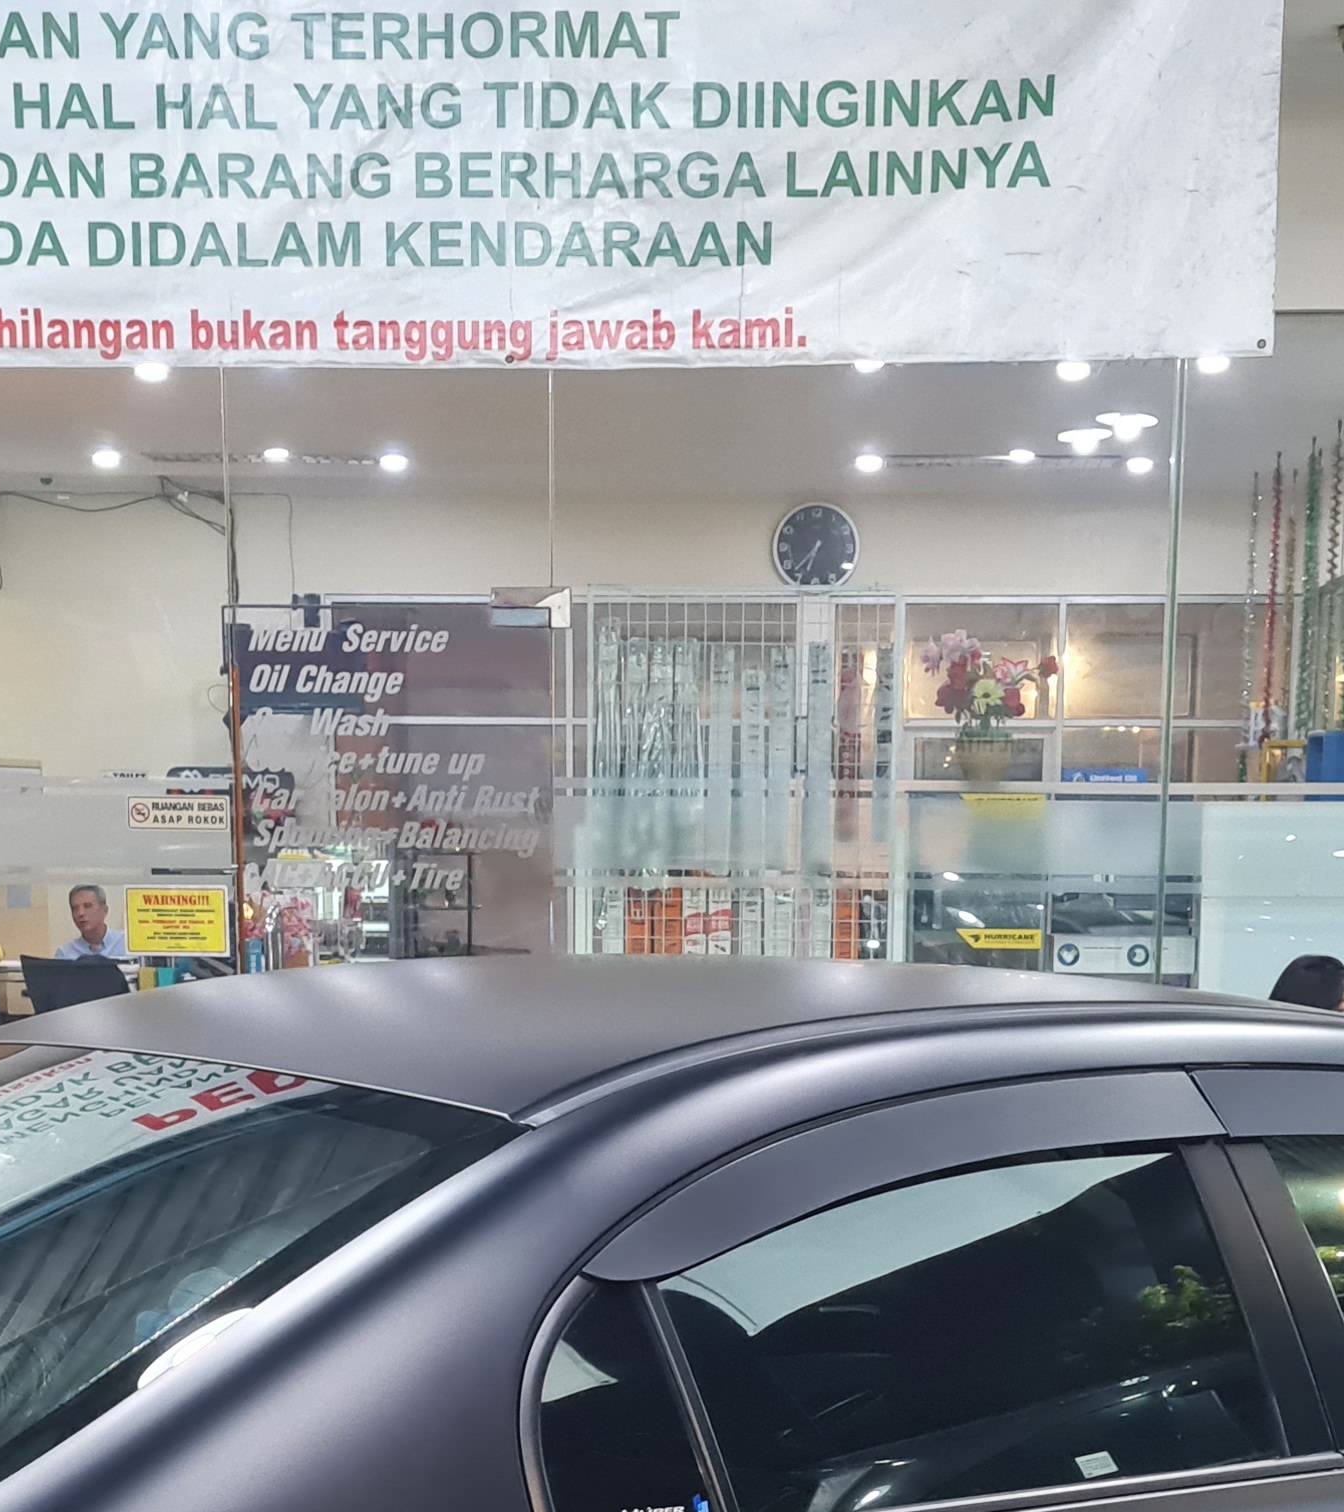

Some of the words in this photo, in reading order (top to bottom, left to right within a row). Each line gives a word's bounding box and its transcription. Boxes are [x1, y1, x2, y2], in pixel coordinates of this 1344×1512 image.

[101, 11, 270, 62] YANG
[290, 11, 680, 61] TERHORMAT
[12, 80, 137, 132] HAL
[156, 84, 275, 132] HAL
[297, 83, 464, 130] YANG
[486, 80, 669, 129] TIDAK
[691, 76, 1056, 129] DIINGINKAN
[129, 152, 391, 201] BARANG
[415, 152, 765, 200] BERHARGA
[787, 139, 1049, 200] LAINNYA
[88, 219, 362, 269] DIDALAM
[385, 221, 773, 269] KENDARAAN
[190, 310, 319, 352] bukan
[333, 313, 533, 363] tanggung
[548, 309, 676, 361] jawab
[691, 310, 807, 350] kami.
[248, 627, 328, 652] Menu
[342, 623, 450, 653] Service
[249, 664, 291, 694] Oil
[295, 664, 404, 703] Change
[309, 707, 391, 737] Wash
[446, 752, 486, 781] up
[151, 801, 194, 811] RUANGAN
[152, 814, 183, 824] ASAP
[187, 815, 226, 825] ROKOK
[983, 932, 1035, 942] HURRICANE
